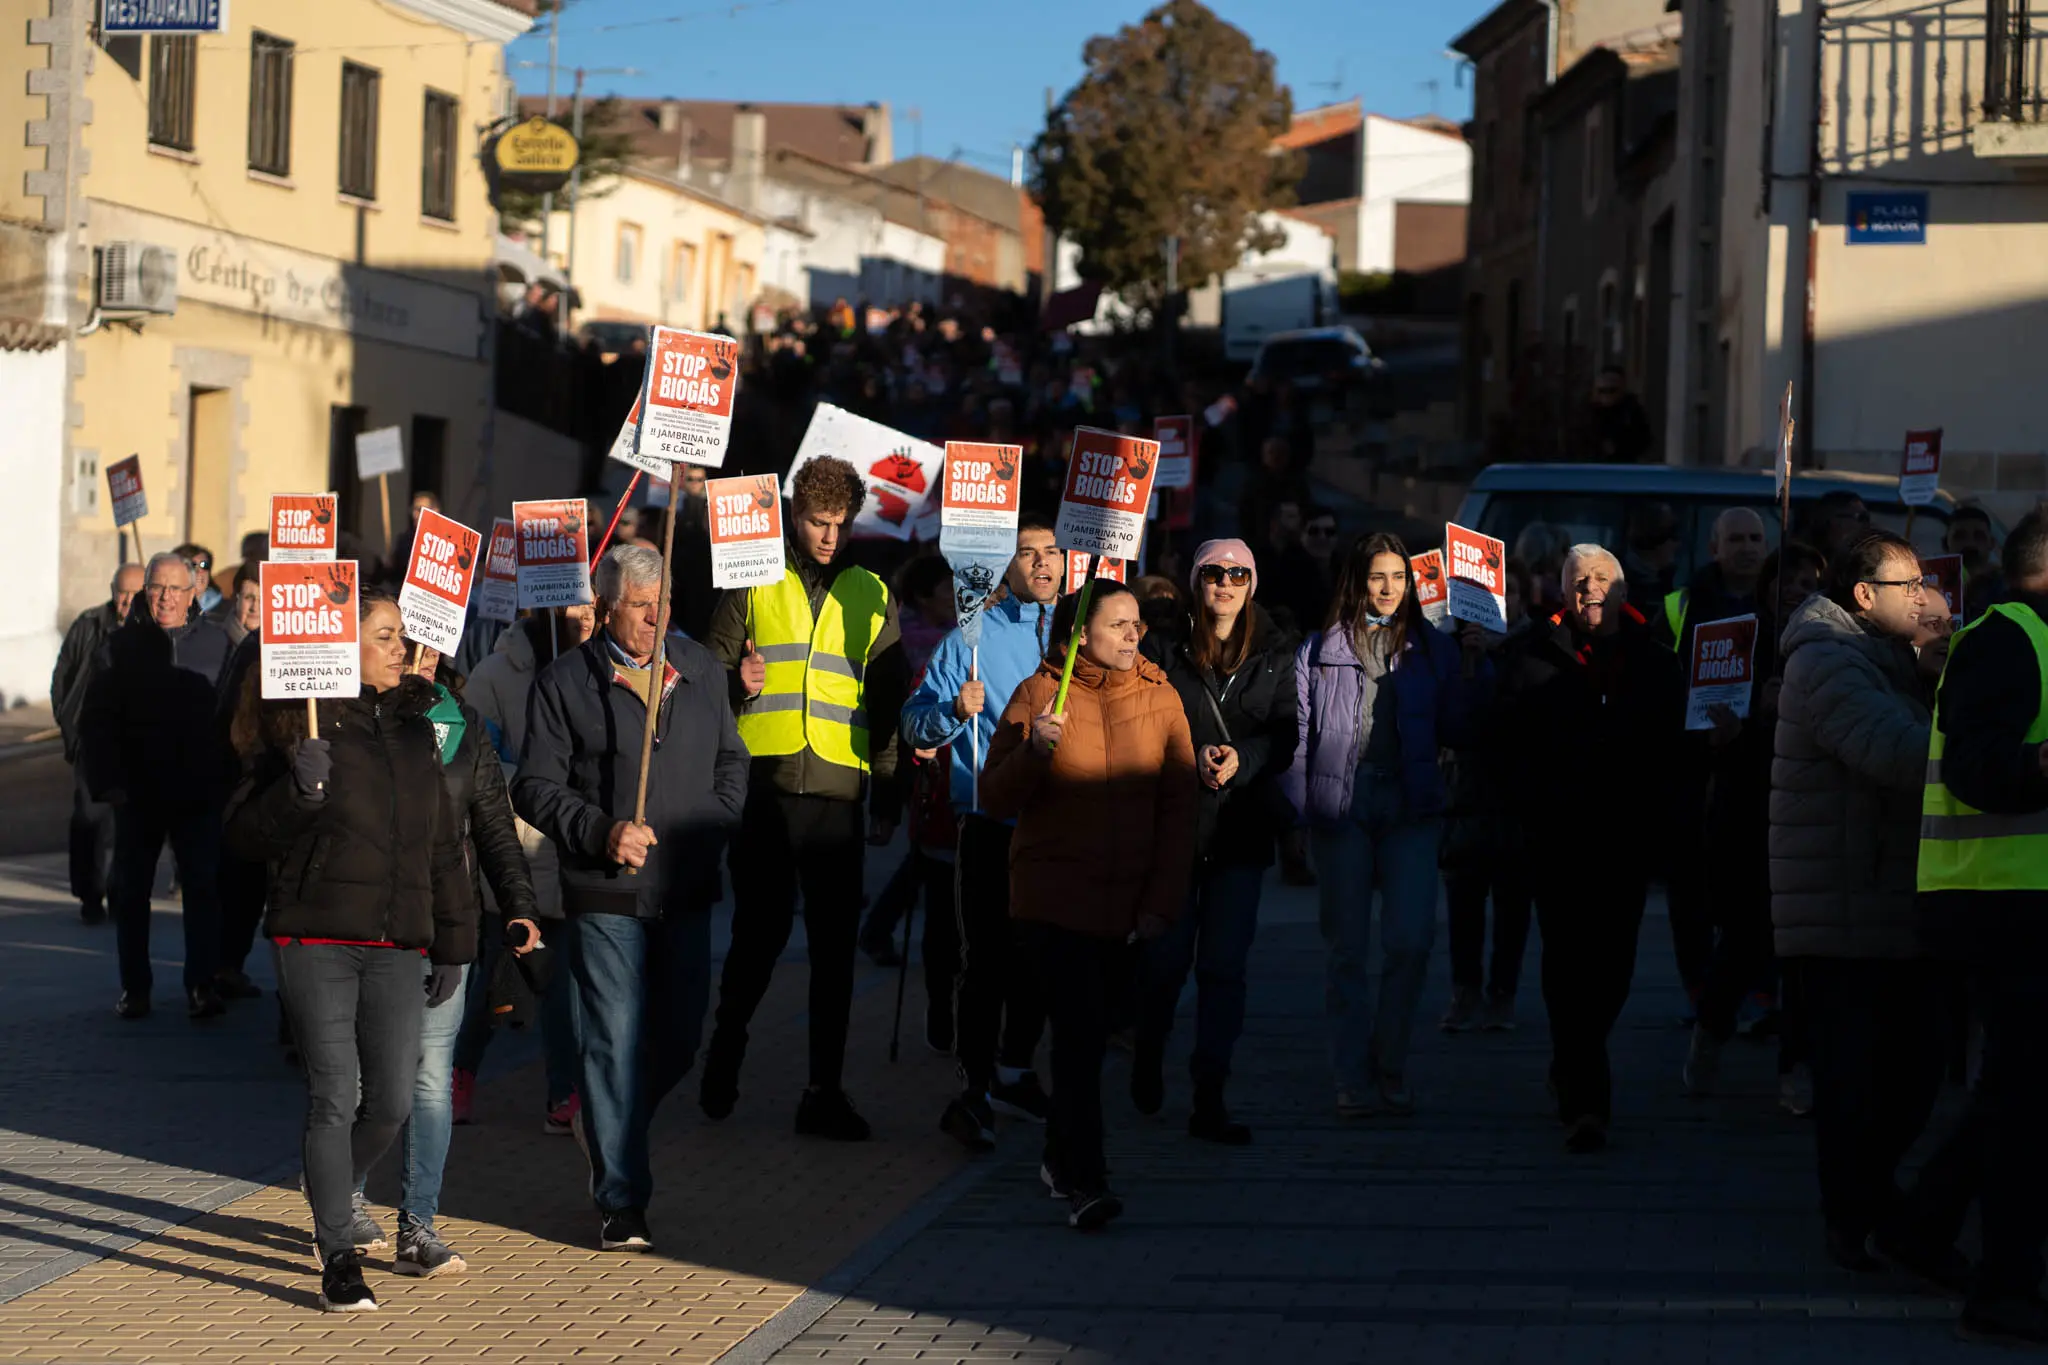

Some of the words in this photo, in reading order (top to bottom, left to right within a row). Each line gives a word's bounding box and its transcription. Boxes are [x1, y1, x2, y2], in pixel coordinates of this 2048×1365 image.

[662, 351, 707, 379] STOP
[659, 375, 720, 407] BIOGÁS
[657, 429, 704, 444] JAMBRINA
[706, 437, 720, 446] NO
[660, 443, 671, 452] SE
[673, 445, 707, 458] CALLA!!
[952, 460, 992, 481] STOP
[1080, 451, 1123, 478] STOP
[951, 480, 1007, 504] BIOGÁS
[1074, 474, 1137, 505] BIOGÁS
[716, 494, 752, 515] STOP
[277, 509, 312, 527] STOP
[522, 518, 559, 538] STOP
[718, 509, 770, 537] BIOGÁS
[277, 524, 326, 544] BIOGÁS
[1070, 524, 1116, 539] JAMBRINA
[1119, 532, 1134, 541] NO
[421, 532, 455, 564] STOP
[524, 534, 577, 560] BIOGÁS
[1073, 537, 1083, 546] SE
[1085, 540, 1119, 552] CALLA!!
[1453, 540, 1483, 565] STOP
[724, 558, 765, 571] JAMBRINA
[766, 557, 779, 565] NO
[1453, 558, 1496, 588] BIOGÁS
[415, 556, 463, 596] BIOGÁS
[572, 581, 584, 589] NO
[729, 572, 738, 580] SE
[271, 583, 321, 609] STOP
[272, 605, 343, 636] BIOGÁS
[407, 609, 443, 631] JAMBRINA
[445, 625, 457, 636] NO
[409, 623, 418, 634] SE
[1701, 638, 1733, 660] STOP
[277, 667, 332, 679] JAMBRINA
[336, 667, 352, 676] NO
[1698, 654, 1744, 680] BIOGÁS
[284, 682, 296, 691] SE
[299, 682, 338, 691] CALLA!!
